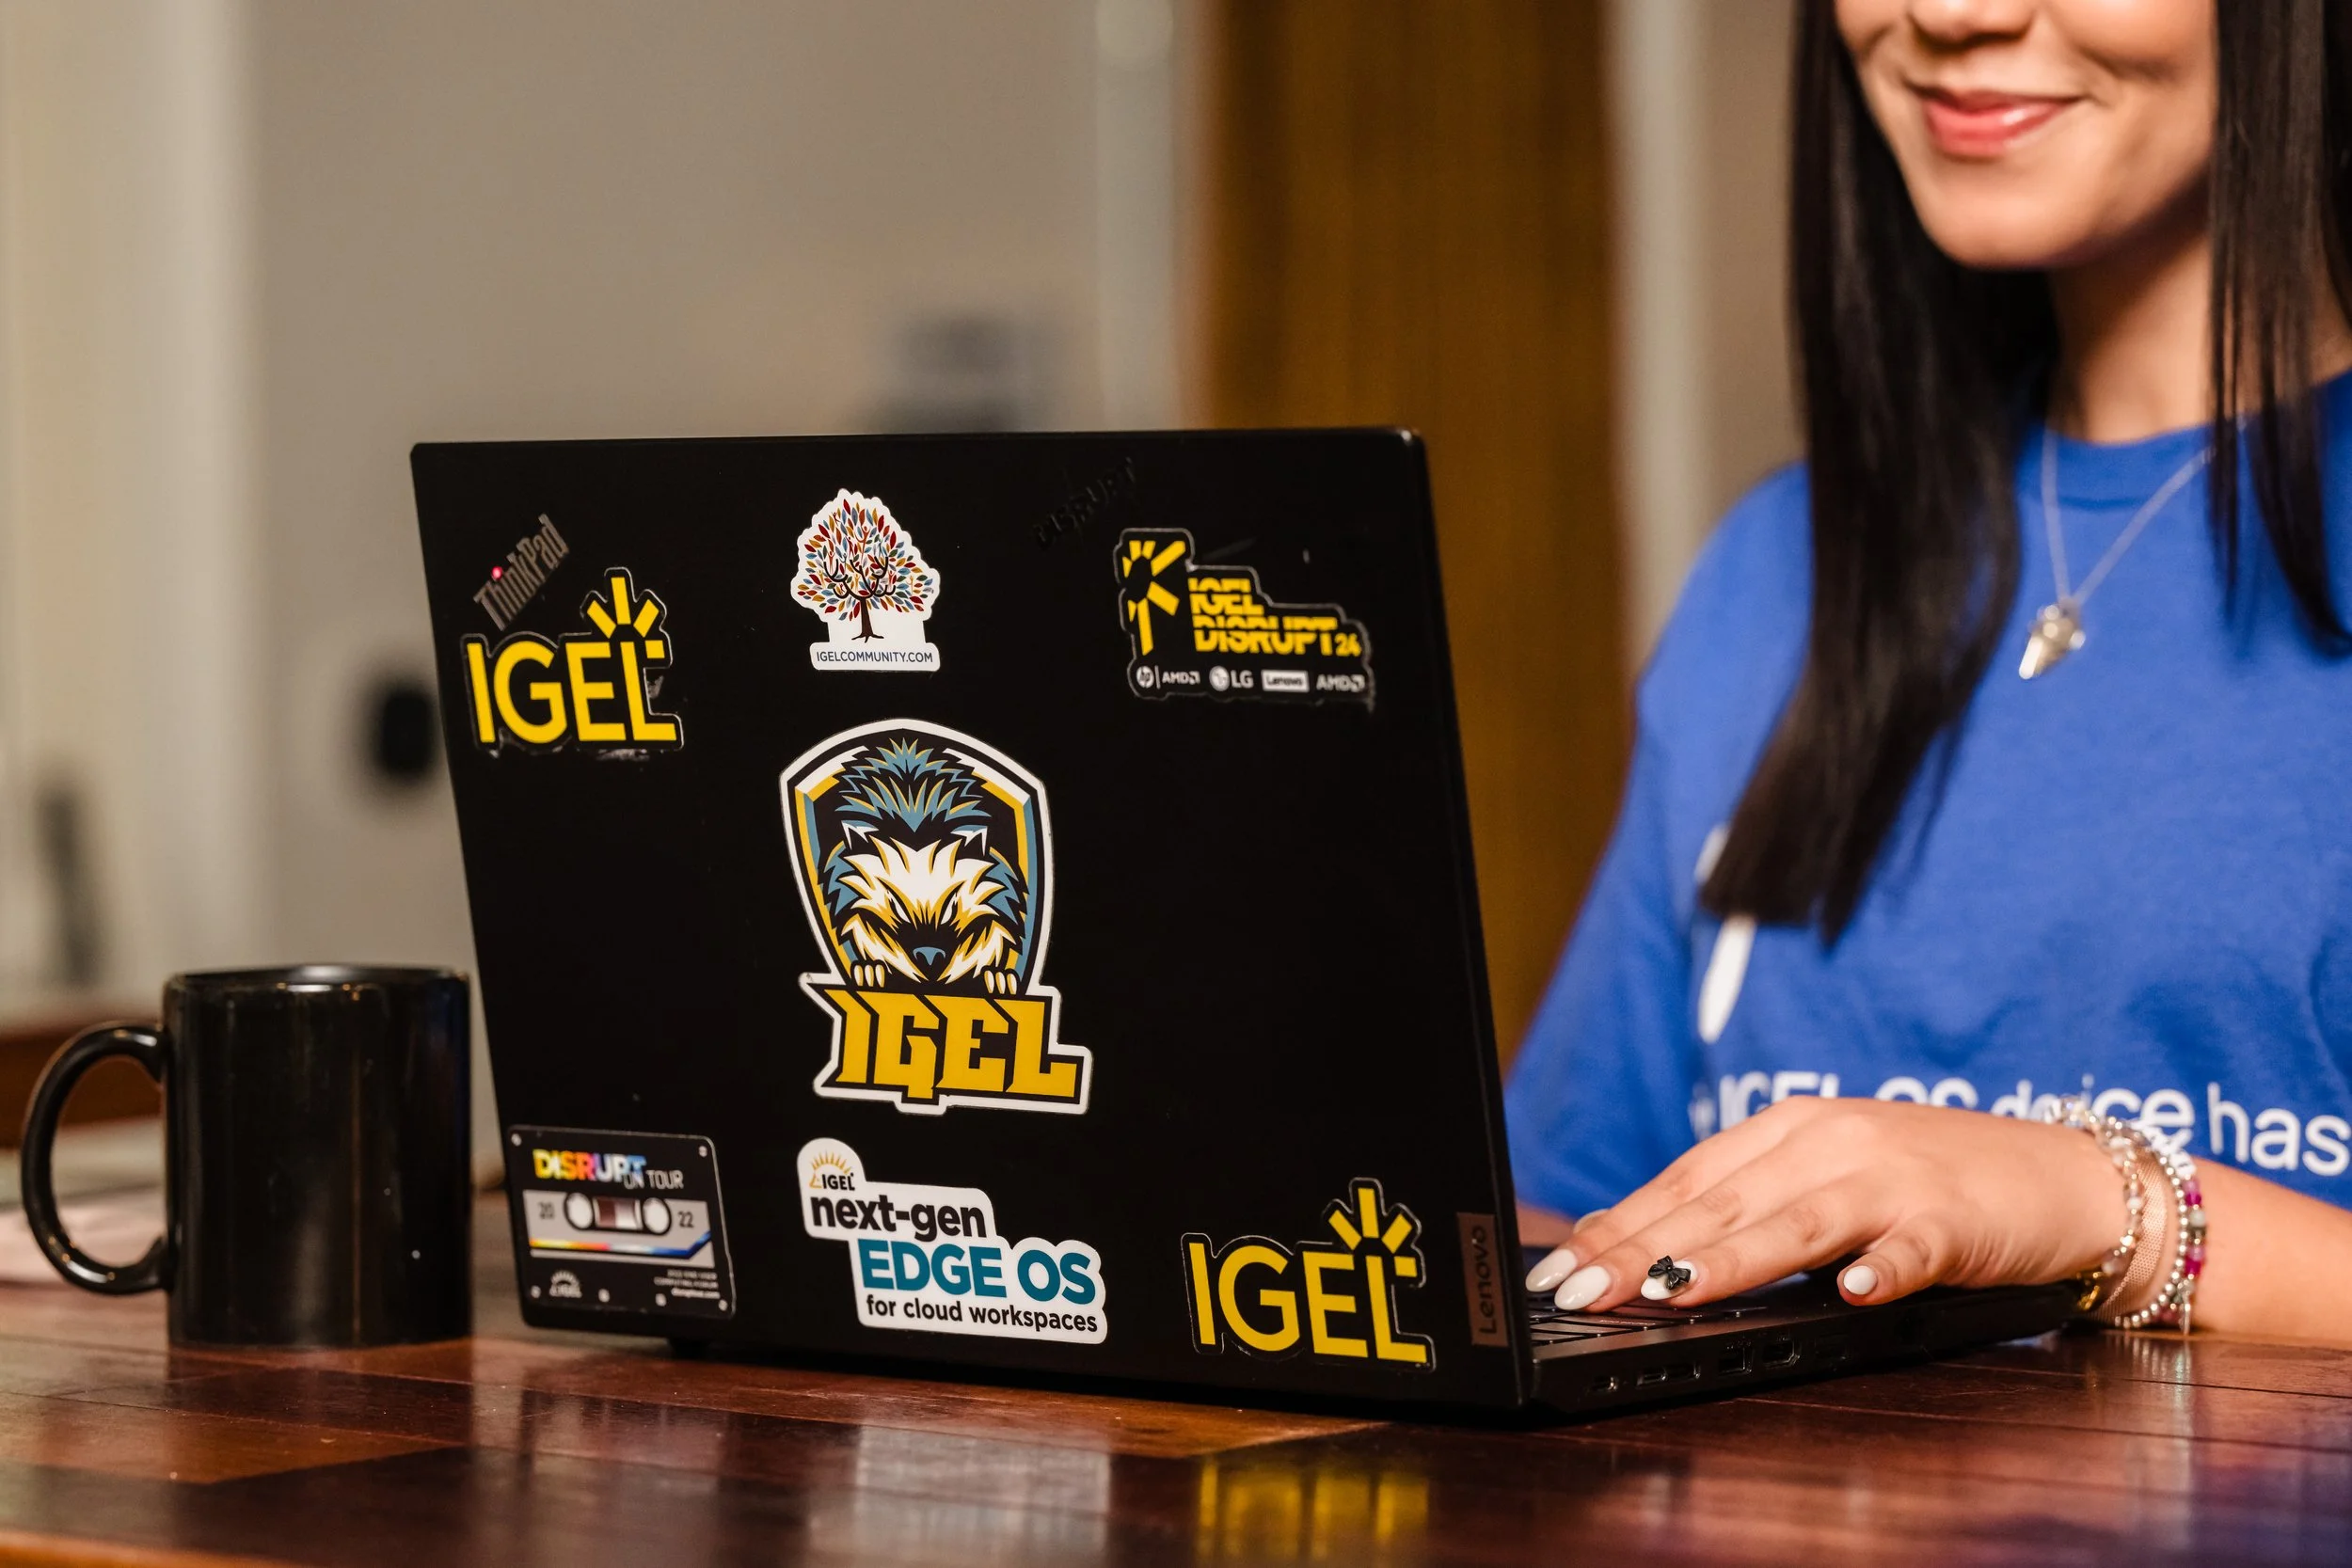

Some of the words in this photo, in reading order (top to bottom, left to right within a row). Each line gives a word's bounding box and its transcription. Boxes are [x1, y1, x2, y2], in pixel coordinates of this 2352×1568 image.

[473, 514, 569, 631] ThinkPad
[1188, 578, 1264, 615] IGEL
[1192, 615, 1338, 655] DISRUPT
[817, 651, 932, 663] IGELCOMMUNITY.COM
[467, 641, 676, 743] IGEL
[1162, 671, 1191, 685] AMD
[1230, 670, 1254, 689] LG
[824, 989, 1077, 1099] IGEL
[2208, 1082, 2352, 1176] has
[532, 1148, 646, 1183] DISRUPT
[645, 1169, 684, 1190] TOUR
[821, 1174, 855, 1191] IGEL
[677, 1211, 694, 1228] 22
[810, 1195, 987, 1242] next-gen
[858, 1238, 1008, 1298] EDGE
[1017, 1249, 1096, 1306] OS
[1471, 1225, 1498, 1334] Lenovo
[866, 1294, 897, 1318] for
[903, 1298, 961, 1322] cloud
[969, 1305, 1098, 1332] workspaces
[1189, 1243, 1427, 1363] IGEL
